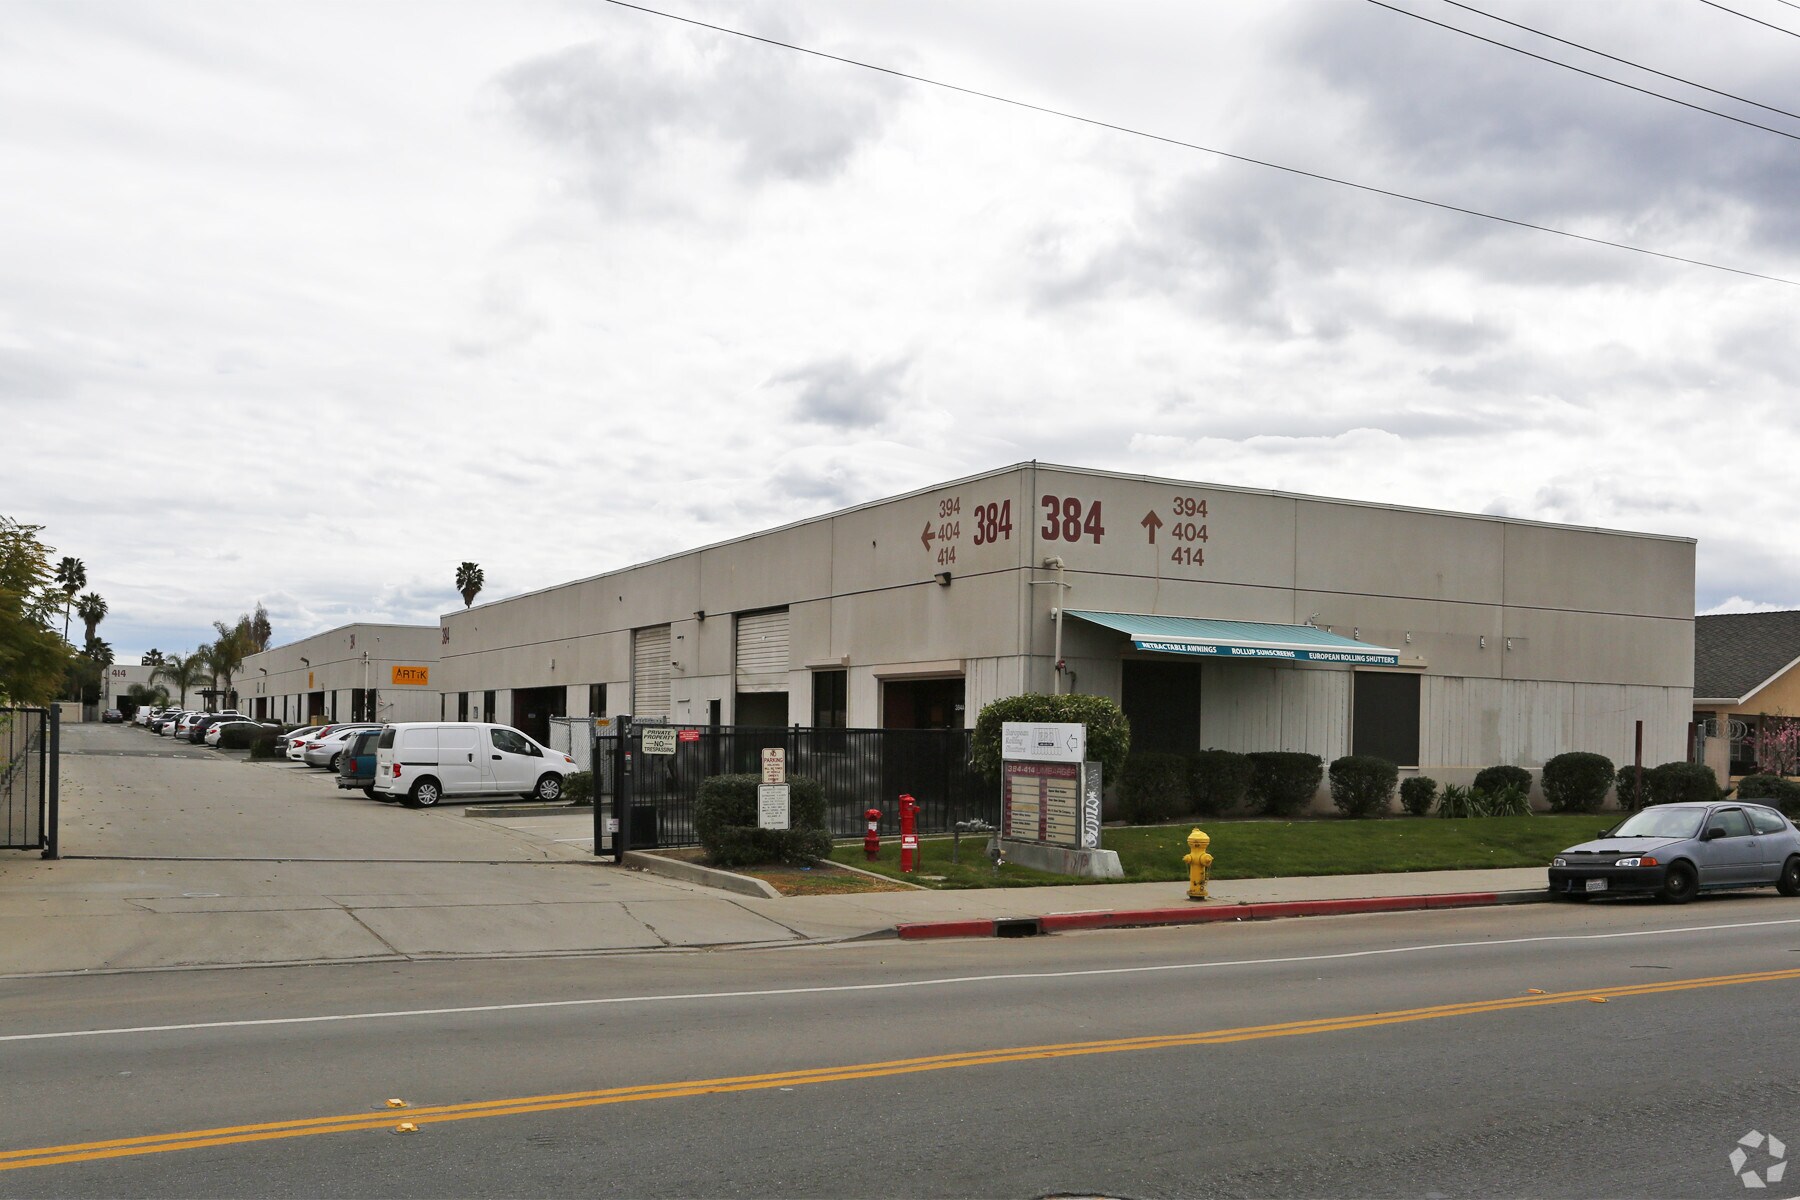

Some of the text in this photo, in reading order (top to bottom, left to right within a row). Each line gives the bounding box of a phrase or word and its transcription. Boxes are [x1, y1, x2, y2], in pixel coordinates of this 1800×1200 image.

[938, 496, 961, 519] 394
[1172, 496, 1208, 518] 394
[973, 499, 1013, 546] 384
[1040, 494, 1105, 545] 384
[937, 520, 961, 543] 404
[1171, 522, 1209, 544] 404
[937, 545, 957, 566] 414
[1171, 546, 1205, 567] 414
[1141, 642, 1217, 654] RETRACTABLE AWNINGS
[1231, 647, 1255, 656] ROLLUP
[1308, 652, 1395, 664] EUROPEAN ROLLING SHUTTERS
[111, 669, 127, 678] 414
